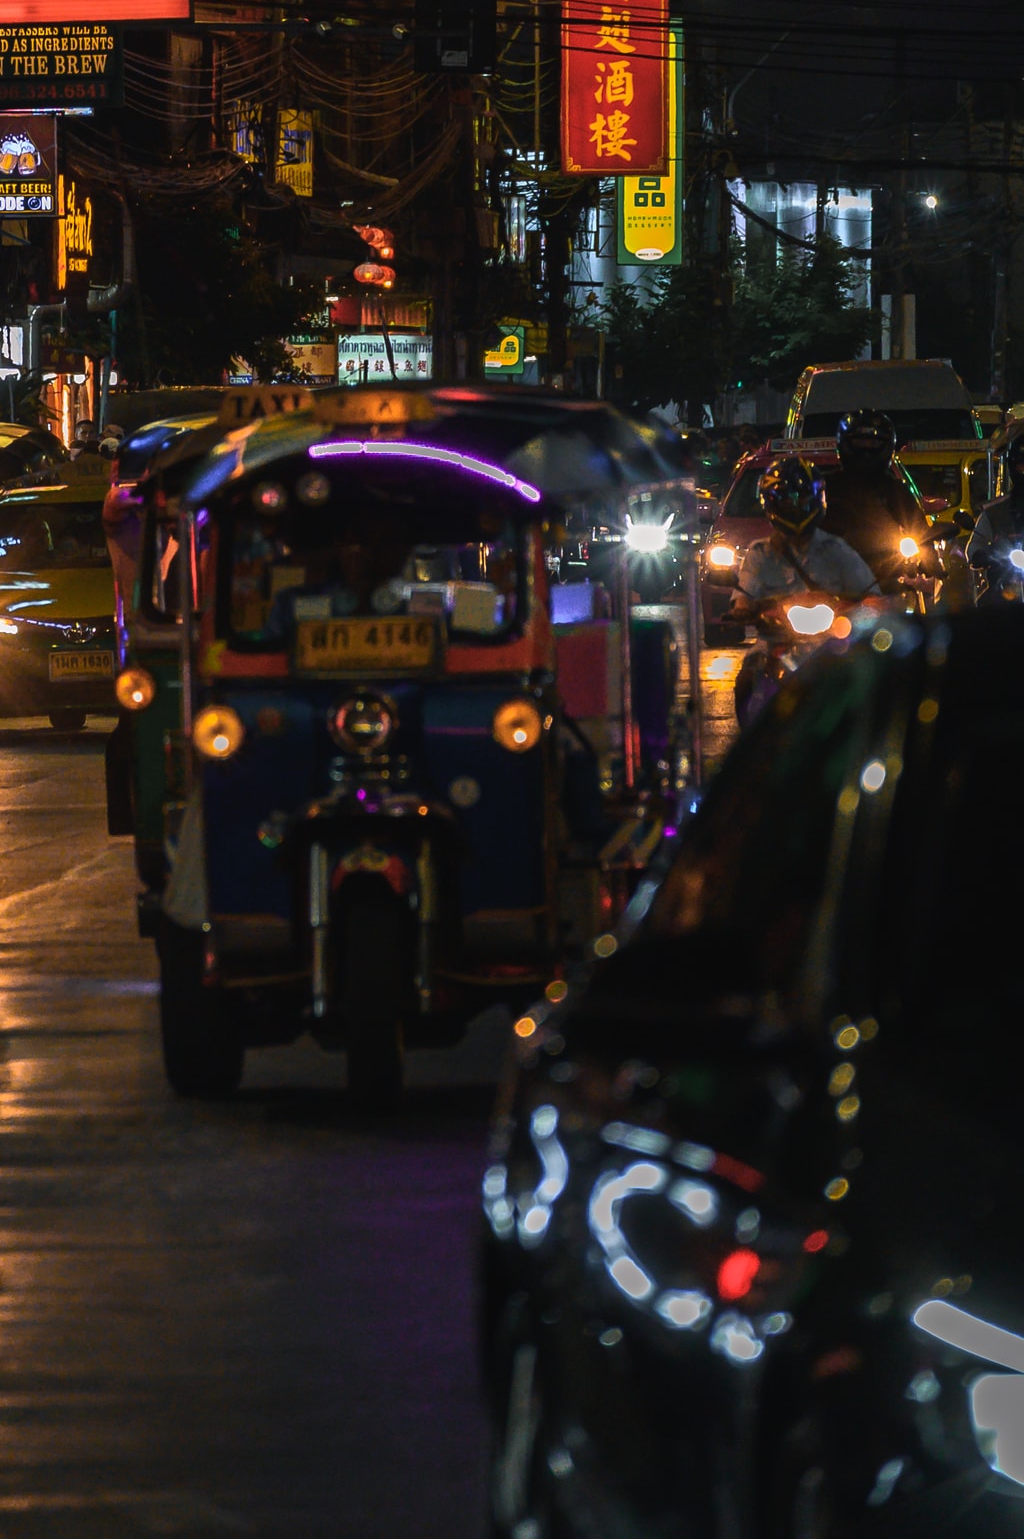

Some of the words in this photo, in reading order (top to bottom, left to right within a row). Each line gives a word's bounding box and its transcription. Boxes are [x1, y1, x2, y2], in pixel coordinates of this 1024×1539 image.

[12, 38, 27, 52] AS
[30, 36, 114, 52] INGREDIENTS
[11, 55, 49, 76] THE
[55, 54, 108, 75] BREW
[21, 183, 52, 194] BEER!
